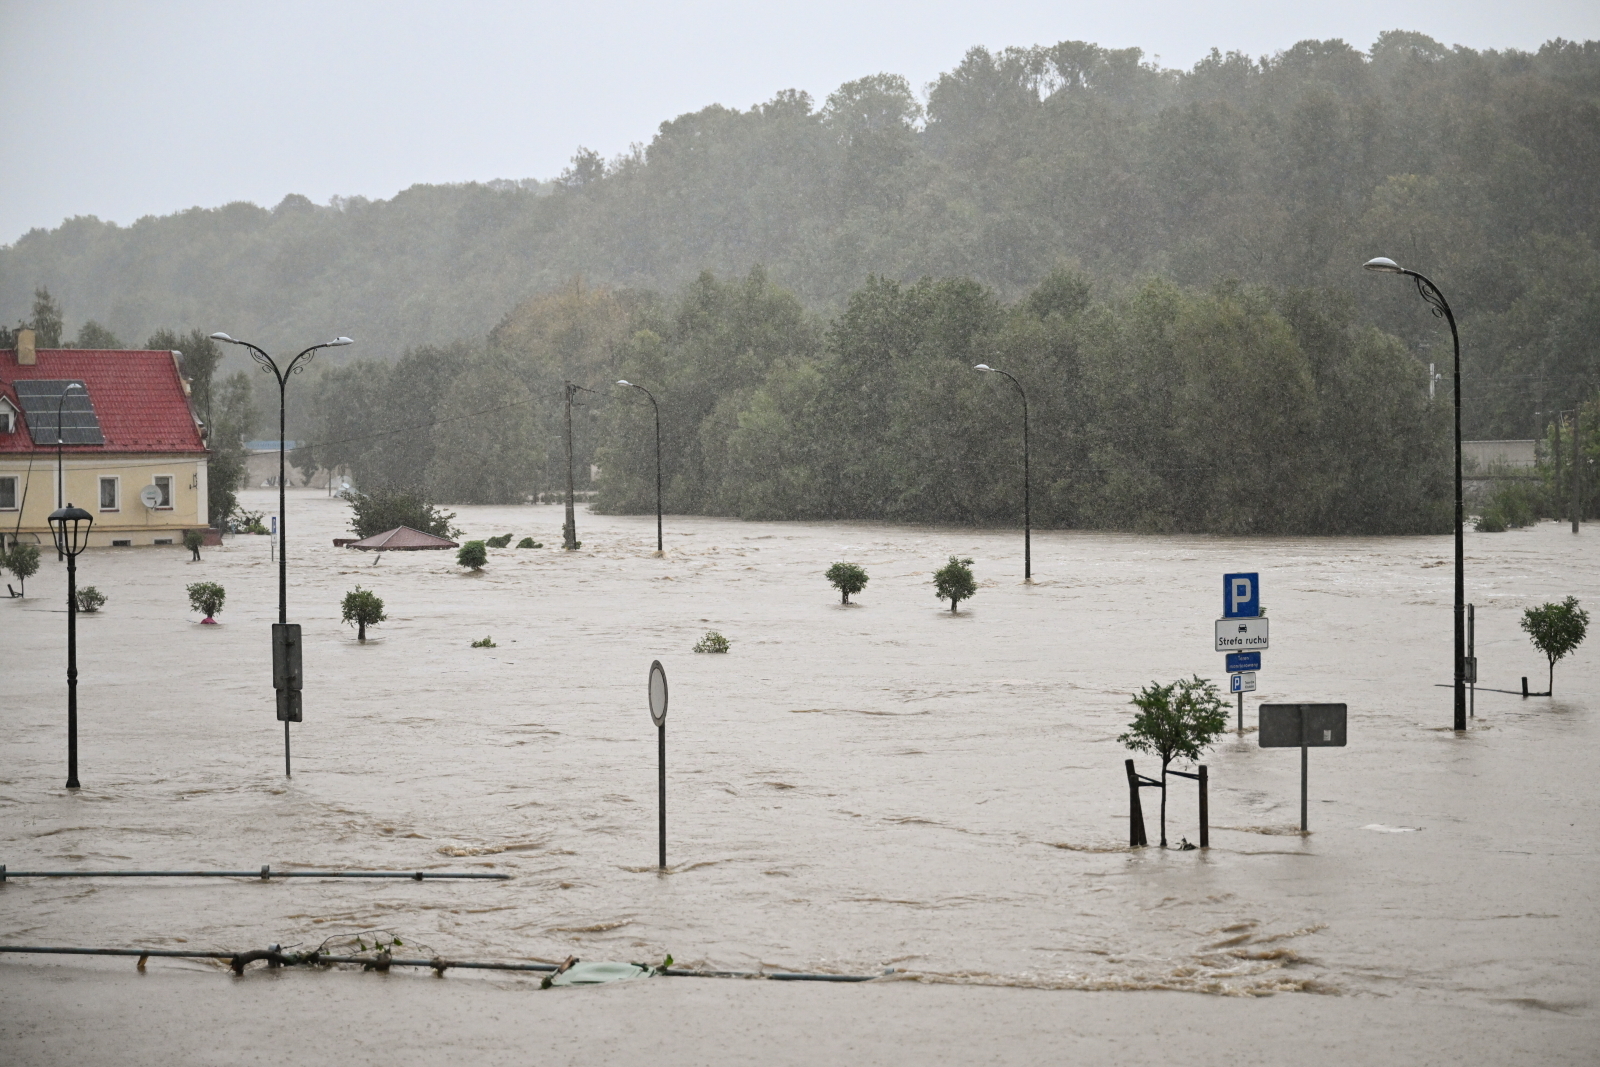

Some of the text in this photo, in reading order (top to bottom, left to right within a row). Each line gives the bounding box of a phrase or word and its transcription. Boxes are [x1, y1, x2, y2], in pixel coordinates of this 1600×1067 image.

[1231, 578, 1251, 612] P
[1218, 635, 1266, 645] Strefa ruchu
[1234, 678, 1239, 689] P
